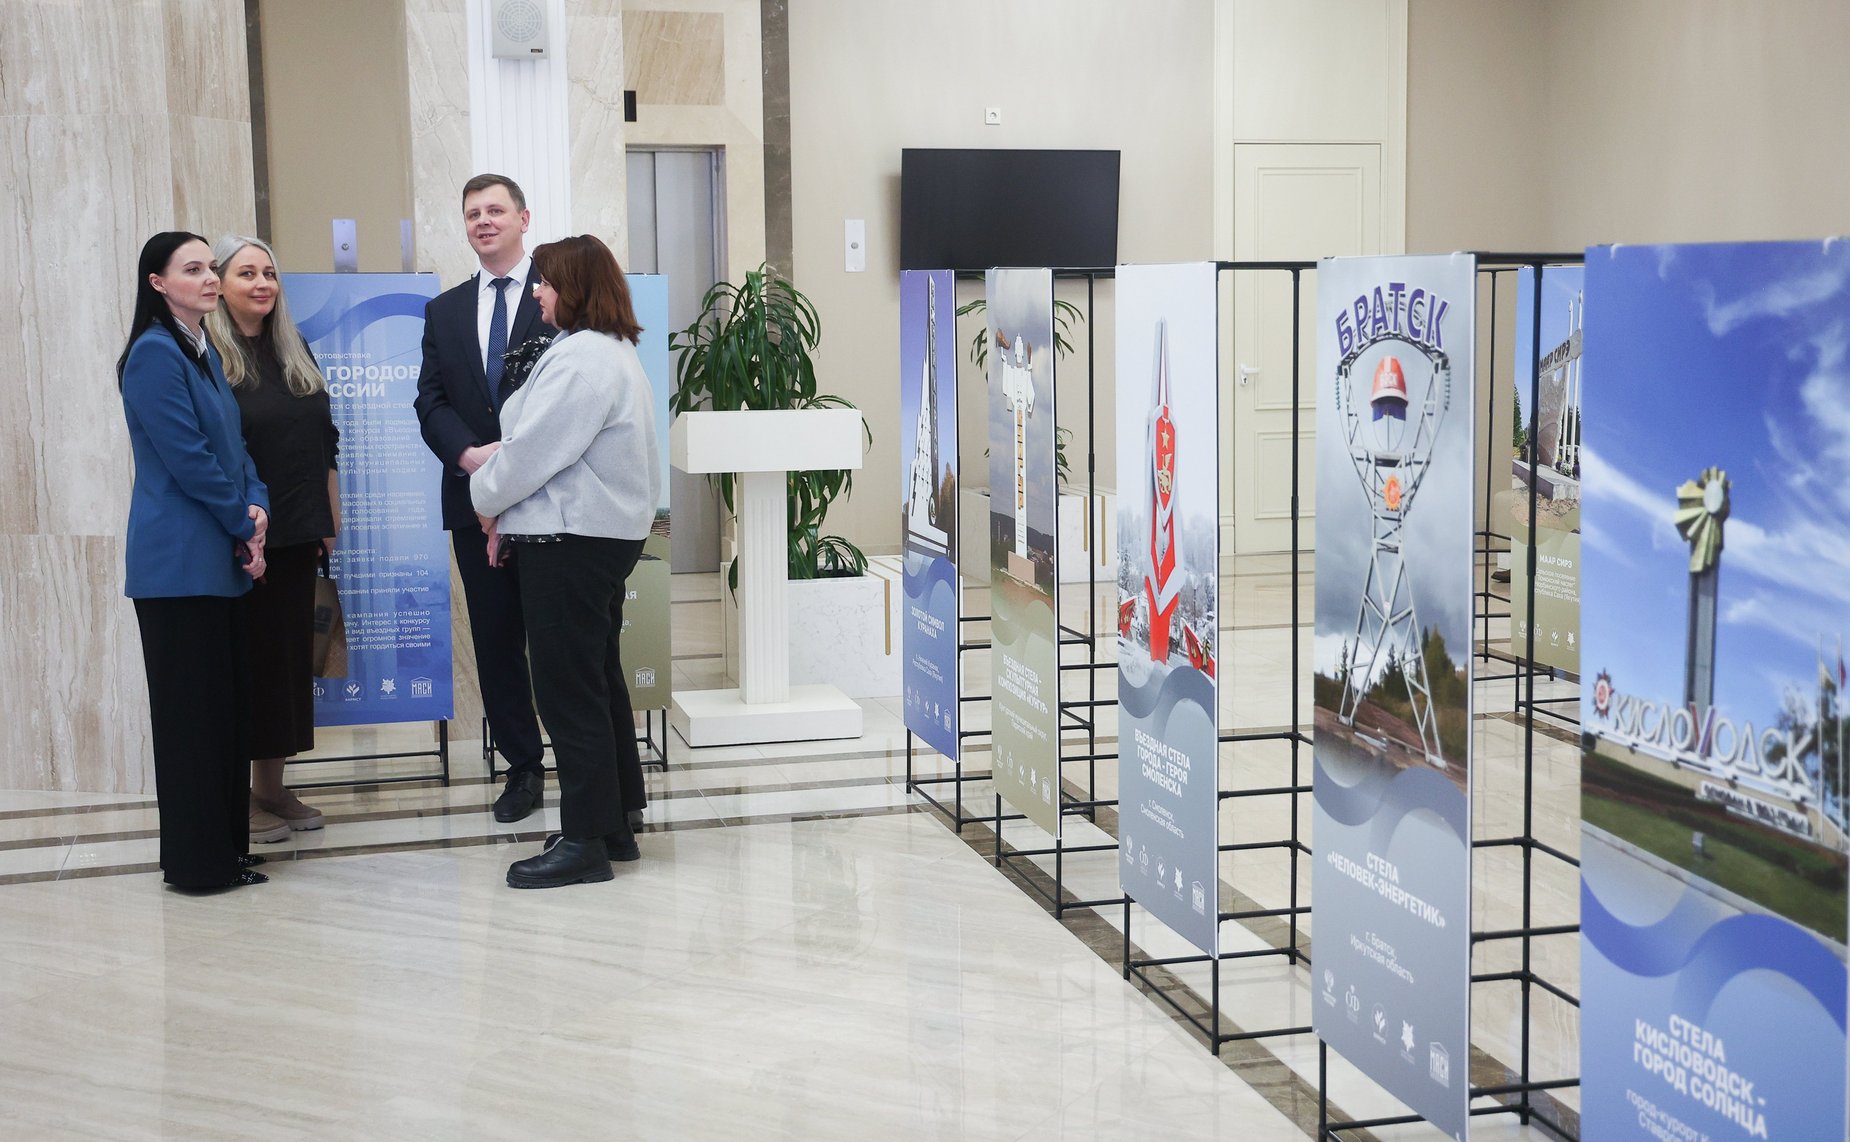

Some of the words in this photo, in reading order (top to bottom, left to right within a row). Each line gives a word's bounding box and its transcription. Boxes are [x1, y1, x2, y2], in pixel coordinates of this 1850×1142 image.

[1335, 282, 1450, 358] БРАТСК
[326, 365, 420, 382] ГОРОДОВ
[327, 382, 385, 398] ССИИ
[341, 516, 382, 524] держивали
[361, 619, 392, 627] Интерес
[400, 618, 431, 626] конкурсу
[393, 610, 431, 618] успешно
[401, 625, 421, 634] групп
[370, 642, 405, 650] гордиться
[1134, 727, 1168, 759] ВЪЕЗДНАЯ
[1168, 747, 1191, 771] СТЕЛА
[1137, 744, 1162, 771] ГОРОДА
[1165, 761, 1188, 785] ГЕРОЯ
[1141, 763, 1183, 798] СМОЛЕНСКА
[1366, 852, 1400, 885] СТЕЛА
[1327, 850, 1446, 928] «ЧЕЛОВЕК-ЭНЕРГЕТИК»
[1350, 933, 1386, 966] Иркутская
[1385, 958, 1415, 984] область
[1669, 1014, 1726, 1063] СТЕЛА
[1635, 1018, 1755, 1105] КИСЛОВОДСК
[1633, 1041, 1688, 1096] ГОРОД
[1690, 1075, 1768, 1141] СОЛНЦА
